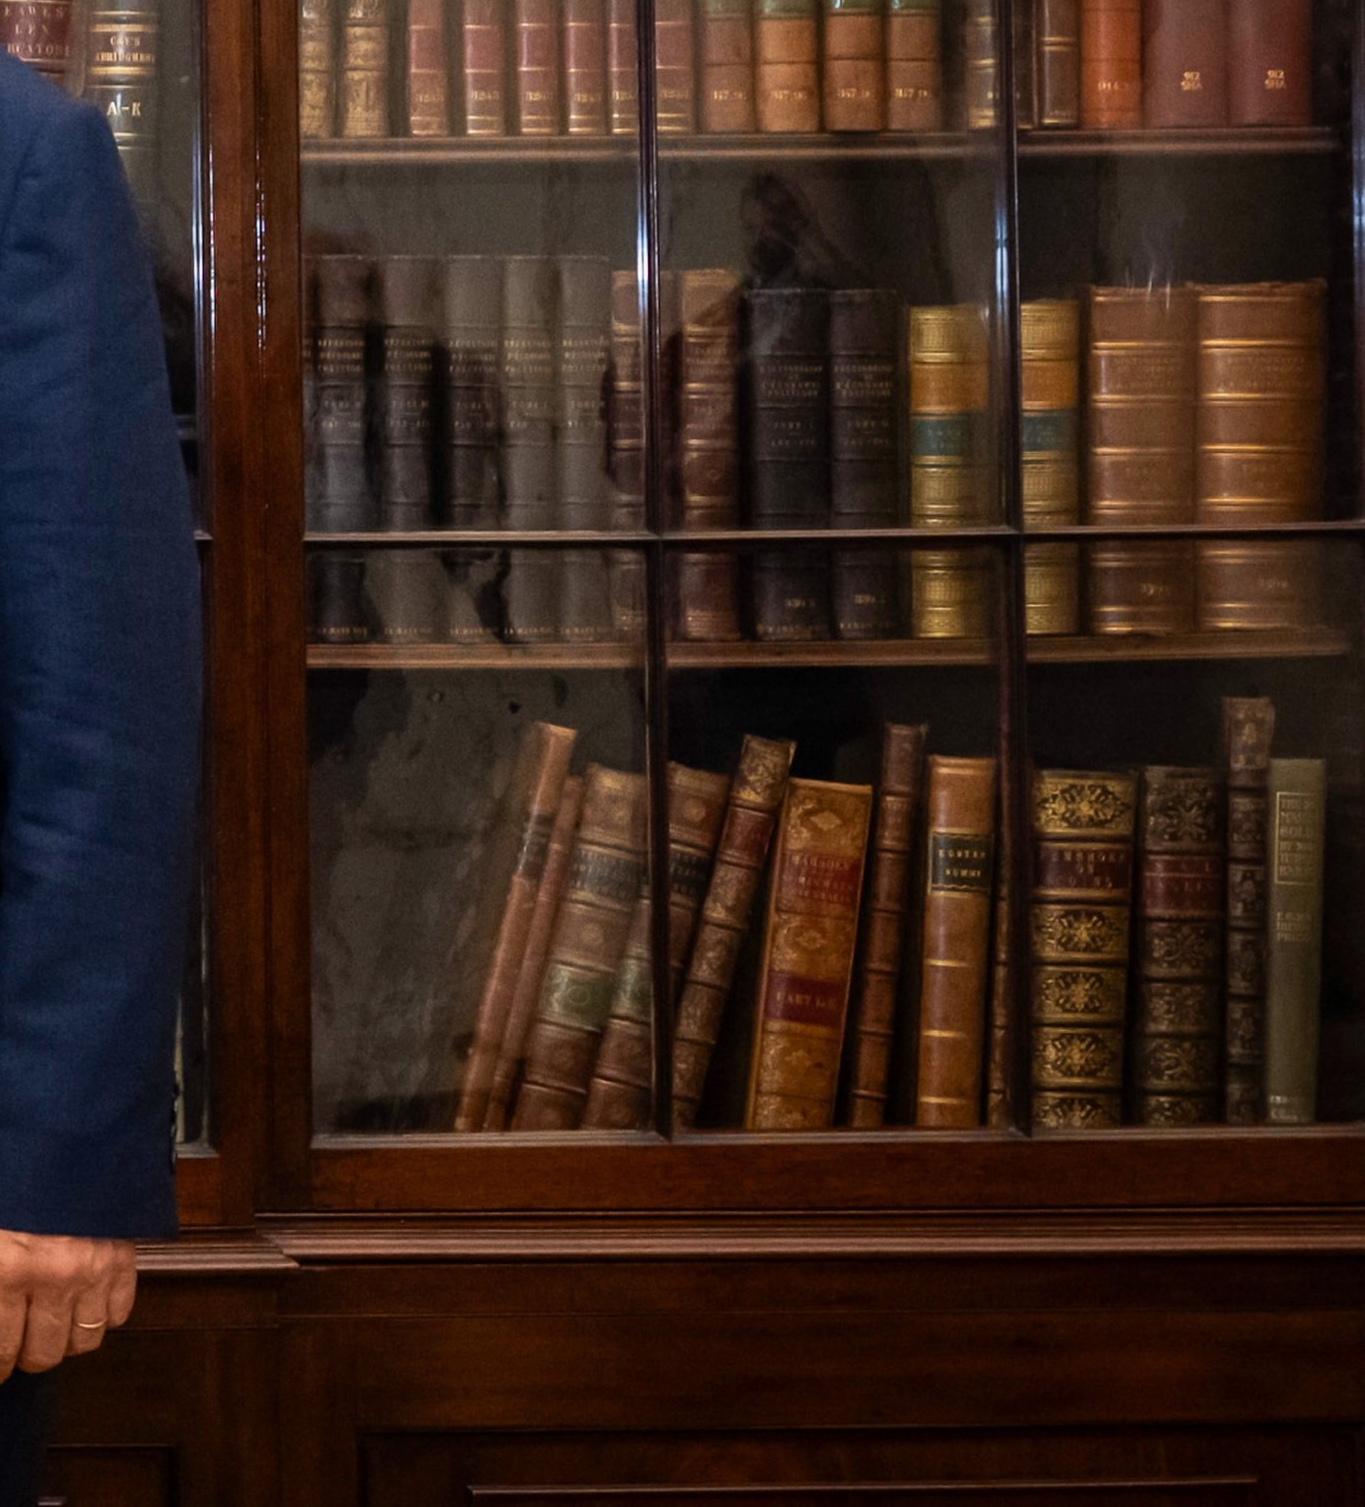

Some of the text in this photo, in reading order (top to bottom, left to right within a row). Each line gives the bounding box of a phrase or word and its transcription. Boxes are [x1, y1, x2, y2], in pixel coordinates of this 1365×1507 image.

[1179, 80, 1203, 91] SHA
[1264, 79, 1287, 90] SHA
[106, 100, 142, 117] A-K
